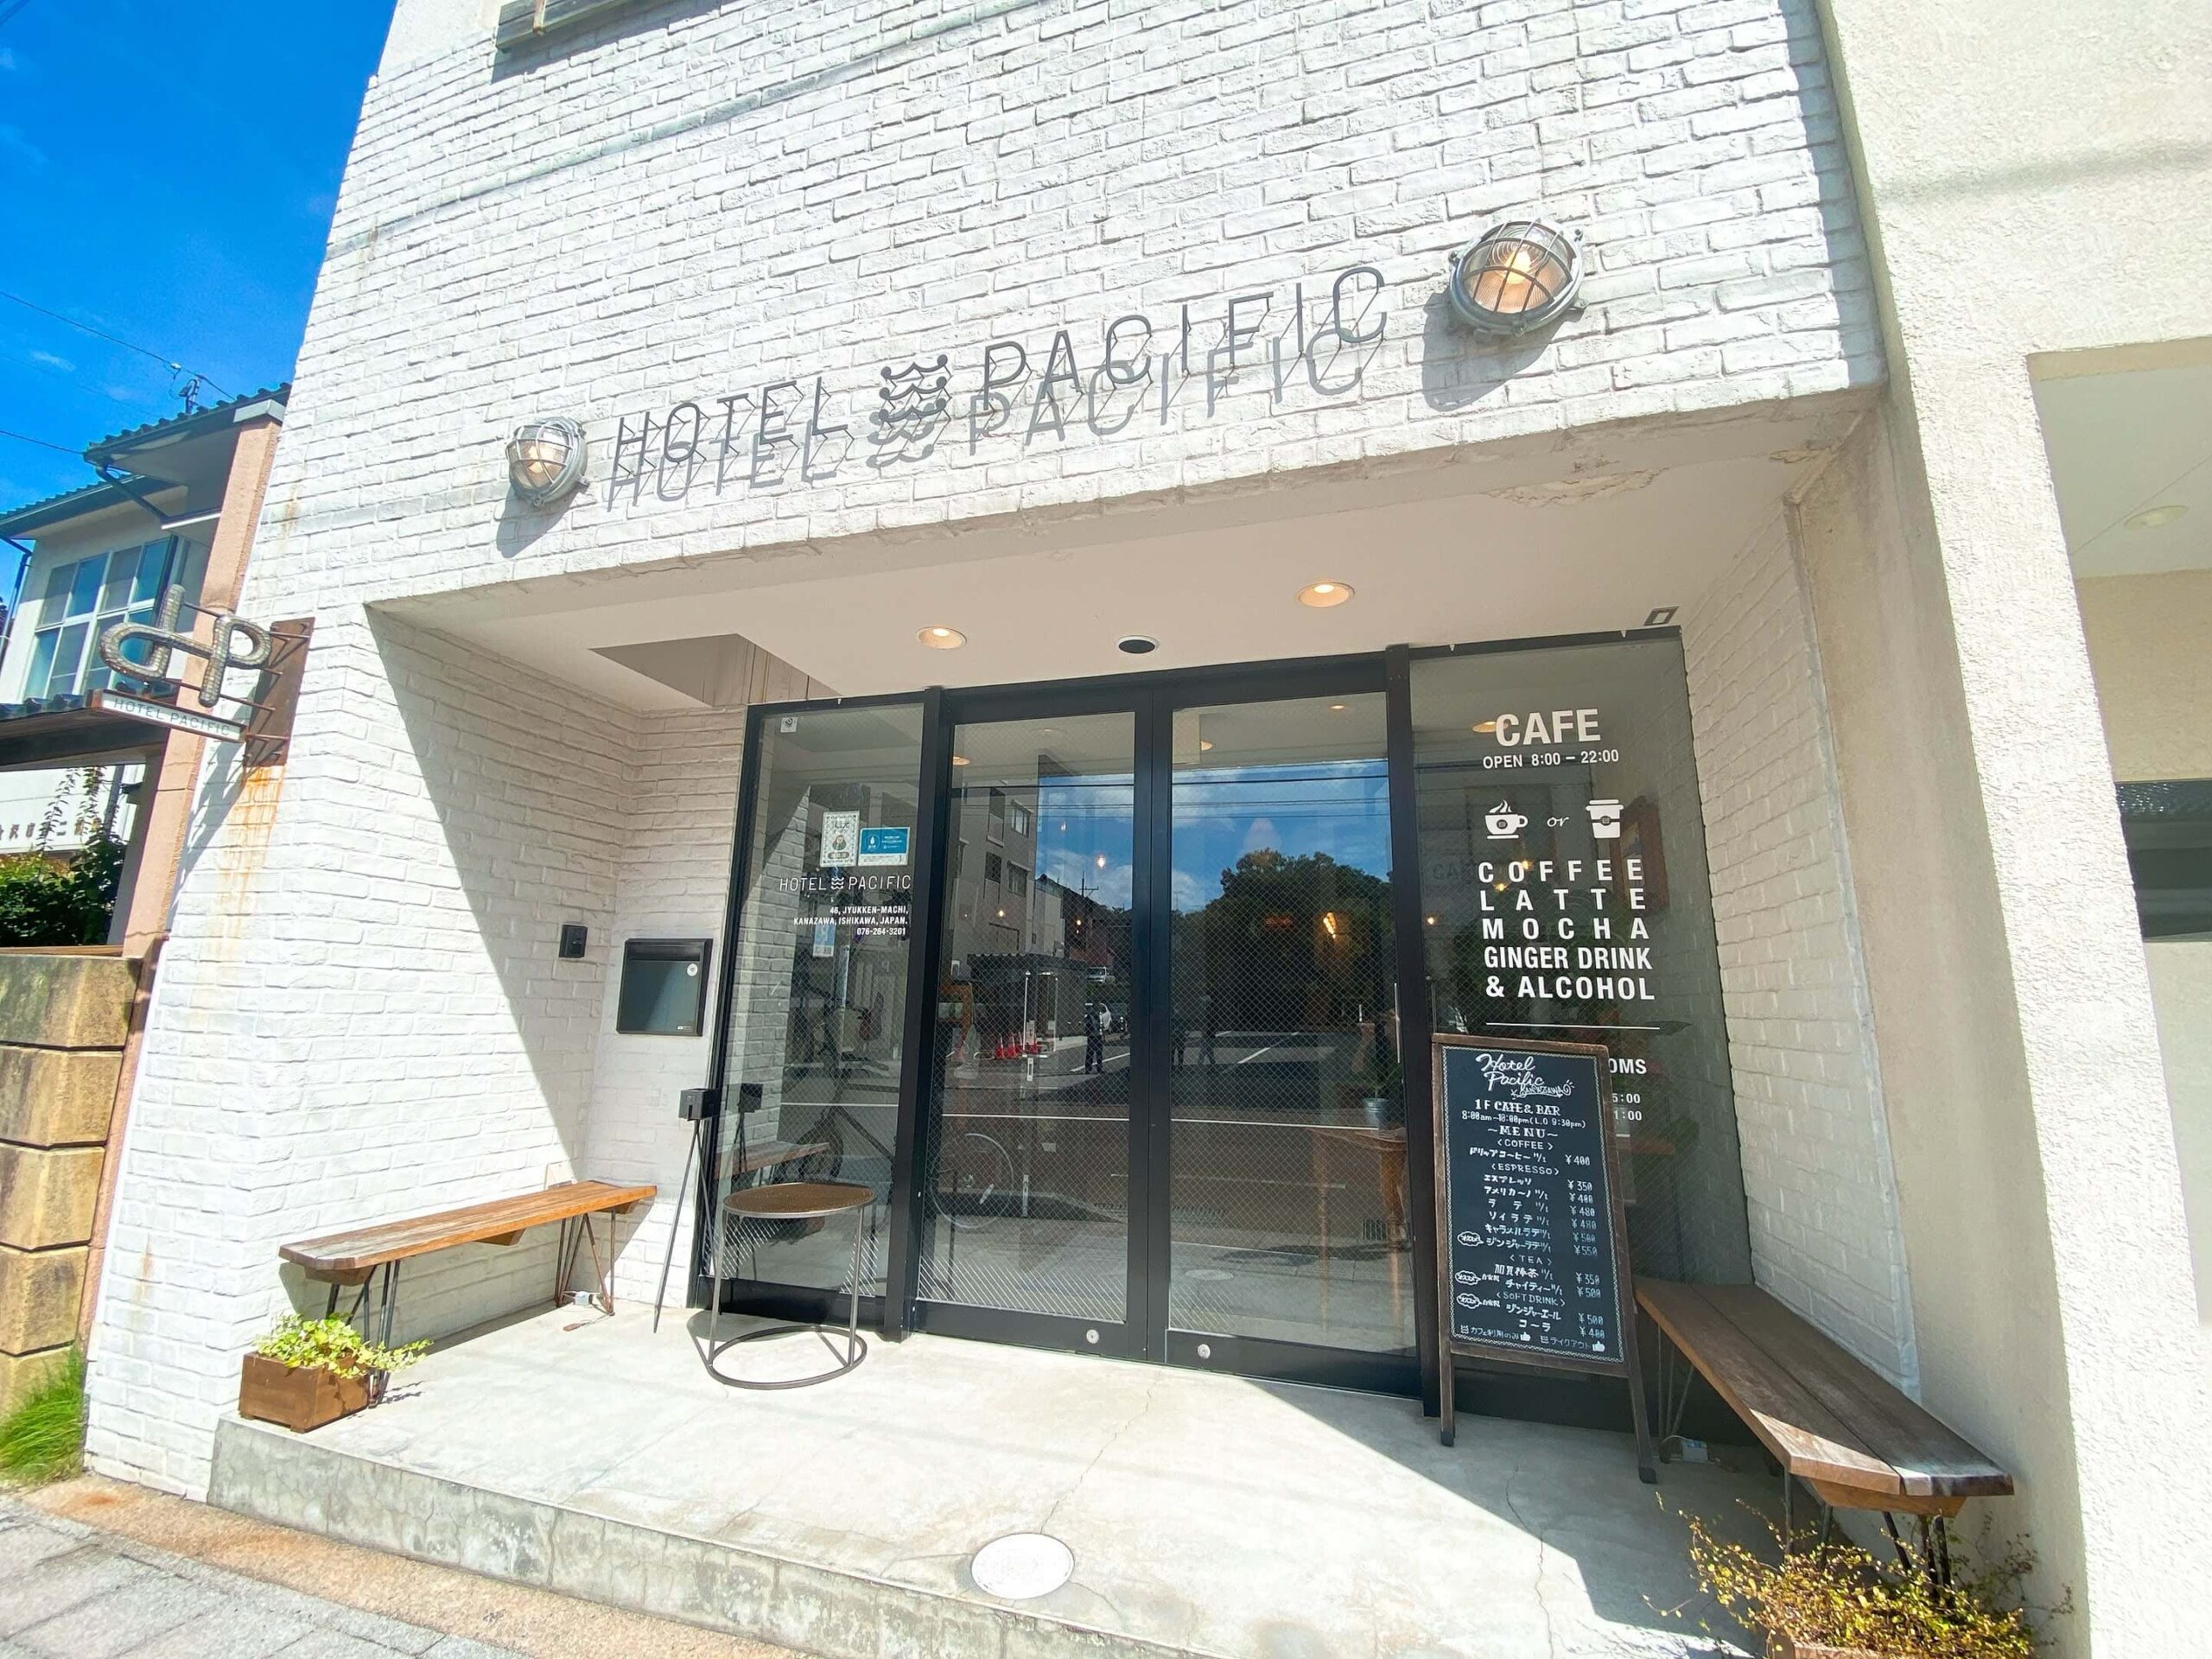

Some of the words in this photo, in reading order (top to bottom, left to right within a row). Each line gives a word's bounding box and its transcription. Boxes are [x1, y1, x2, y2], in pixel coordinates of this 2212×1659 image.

[619, 377, 849, 465] HOTEL
[982, 266, 1388, 420] PACIFIC
[114, 698, 164, 720] HOTEL
[170, 712, 230, 736] PACIFIC
[1496, 709, 1601, 747] CAFE
[1483, 753, 1523, 769] OPEN
[1531, 752, 1561, 766] 8:00
[1580, 749, 1619, 764] 22:00
[1547, 817, 1569, 828] or
[1478, 858, 1643, 883] COFFEE
[779, 876, 827, 891] HOTEL
[849, 874, 912, 890] PACIFIC
[1480, 887, 1646, 911] LATTE
[842, 905, 909, 914] JYUKKEN-MACHI,
[793, 917, 837, 925] KANAZAWA,
[838, 917, 878, 925] ISHIKAWA,
[880, 916, 908, 925] JAPAN.
[1482, 917, 1649, 940] MOCHA
[856, 927, 906, 936] 076-264-3201
[1484, 946, 1569, 969] GINGER
[1578, 947, 1652, 970] DRINK
[1485, 976, 1505, 997] &
[1517, 976, 1656, 1001] ALCOHOL
[1475, 1053, 1535, 1071] Hotel
[1484, 1071, 1545, 1092] Pacific
[1535, 1104, 1561, 1116] BAR
[1484, 1174, 1532, 1185] エスプレッソ
[1484, 1185, 1531, 1198] アメリカーノ
[1494, 1263, 1539, 1278] 加賀棒茶
